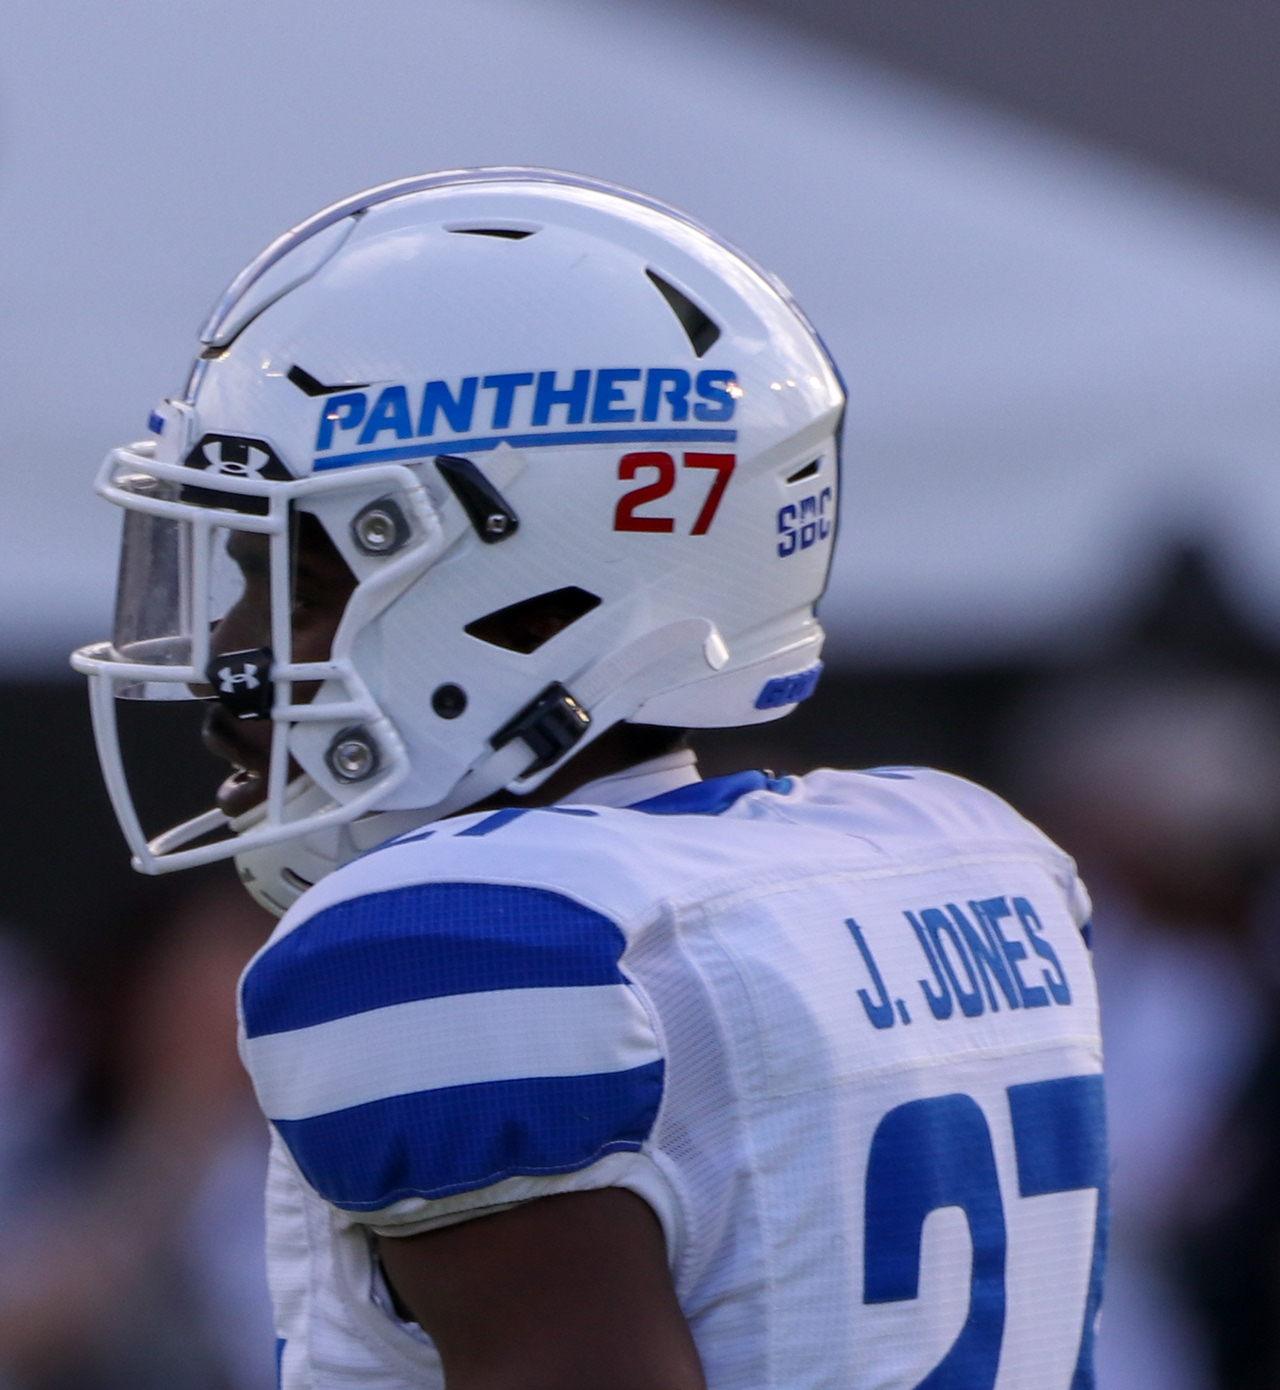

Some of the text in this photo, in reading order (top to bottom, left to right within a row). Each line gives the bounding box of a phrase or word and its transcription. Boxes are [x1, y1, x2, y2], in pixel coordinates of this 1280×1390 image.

[315, 367, 738, 452] PANTHERS
[613, 451, 737, 536] 27
[777, 486, 832, 559] SBC
[844, 895, 1072, 1030] J. JONES
